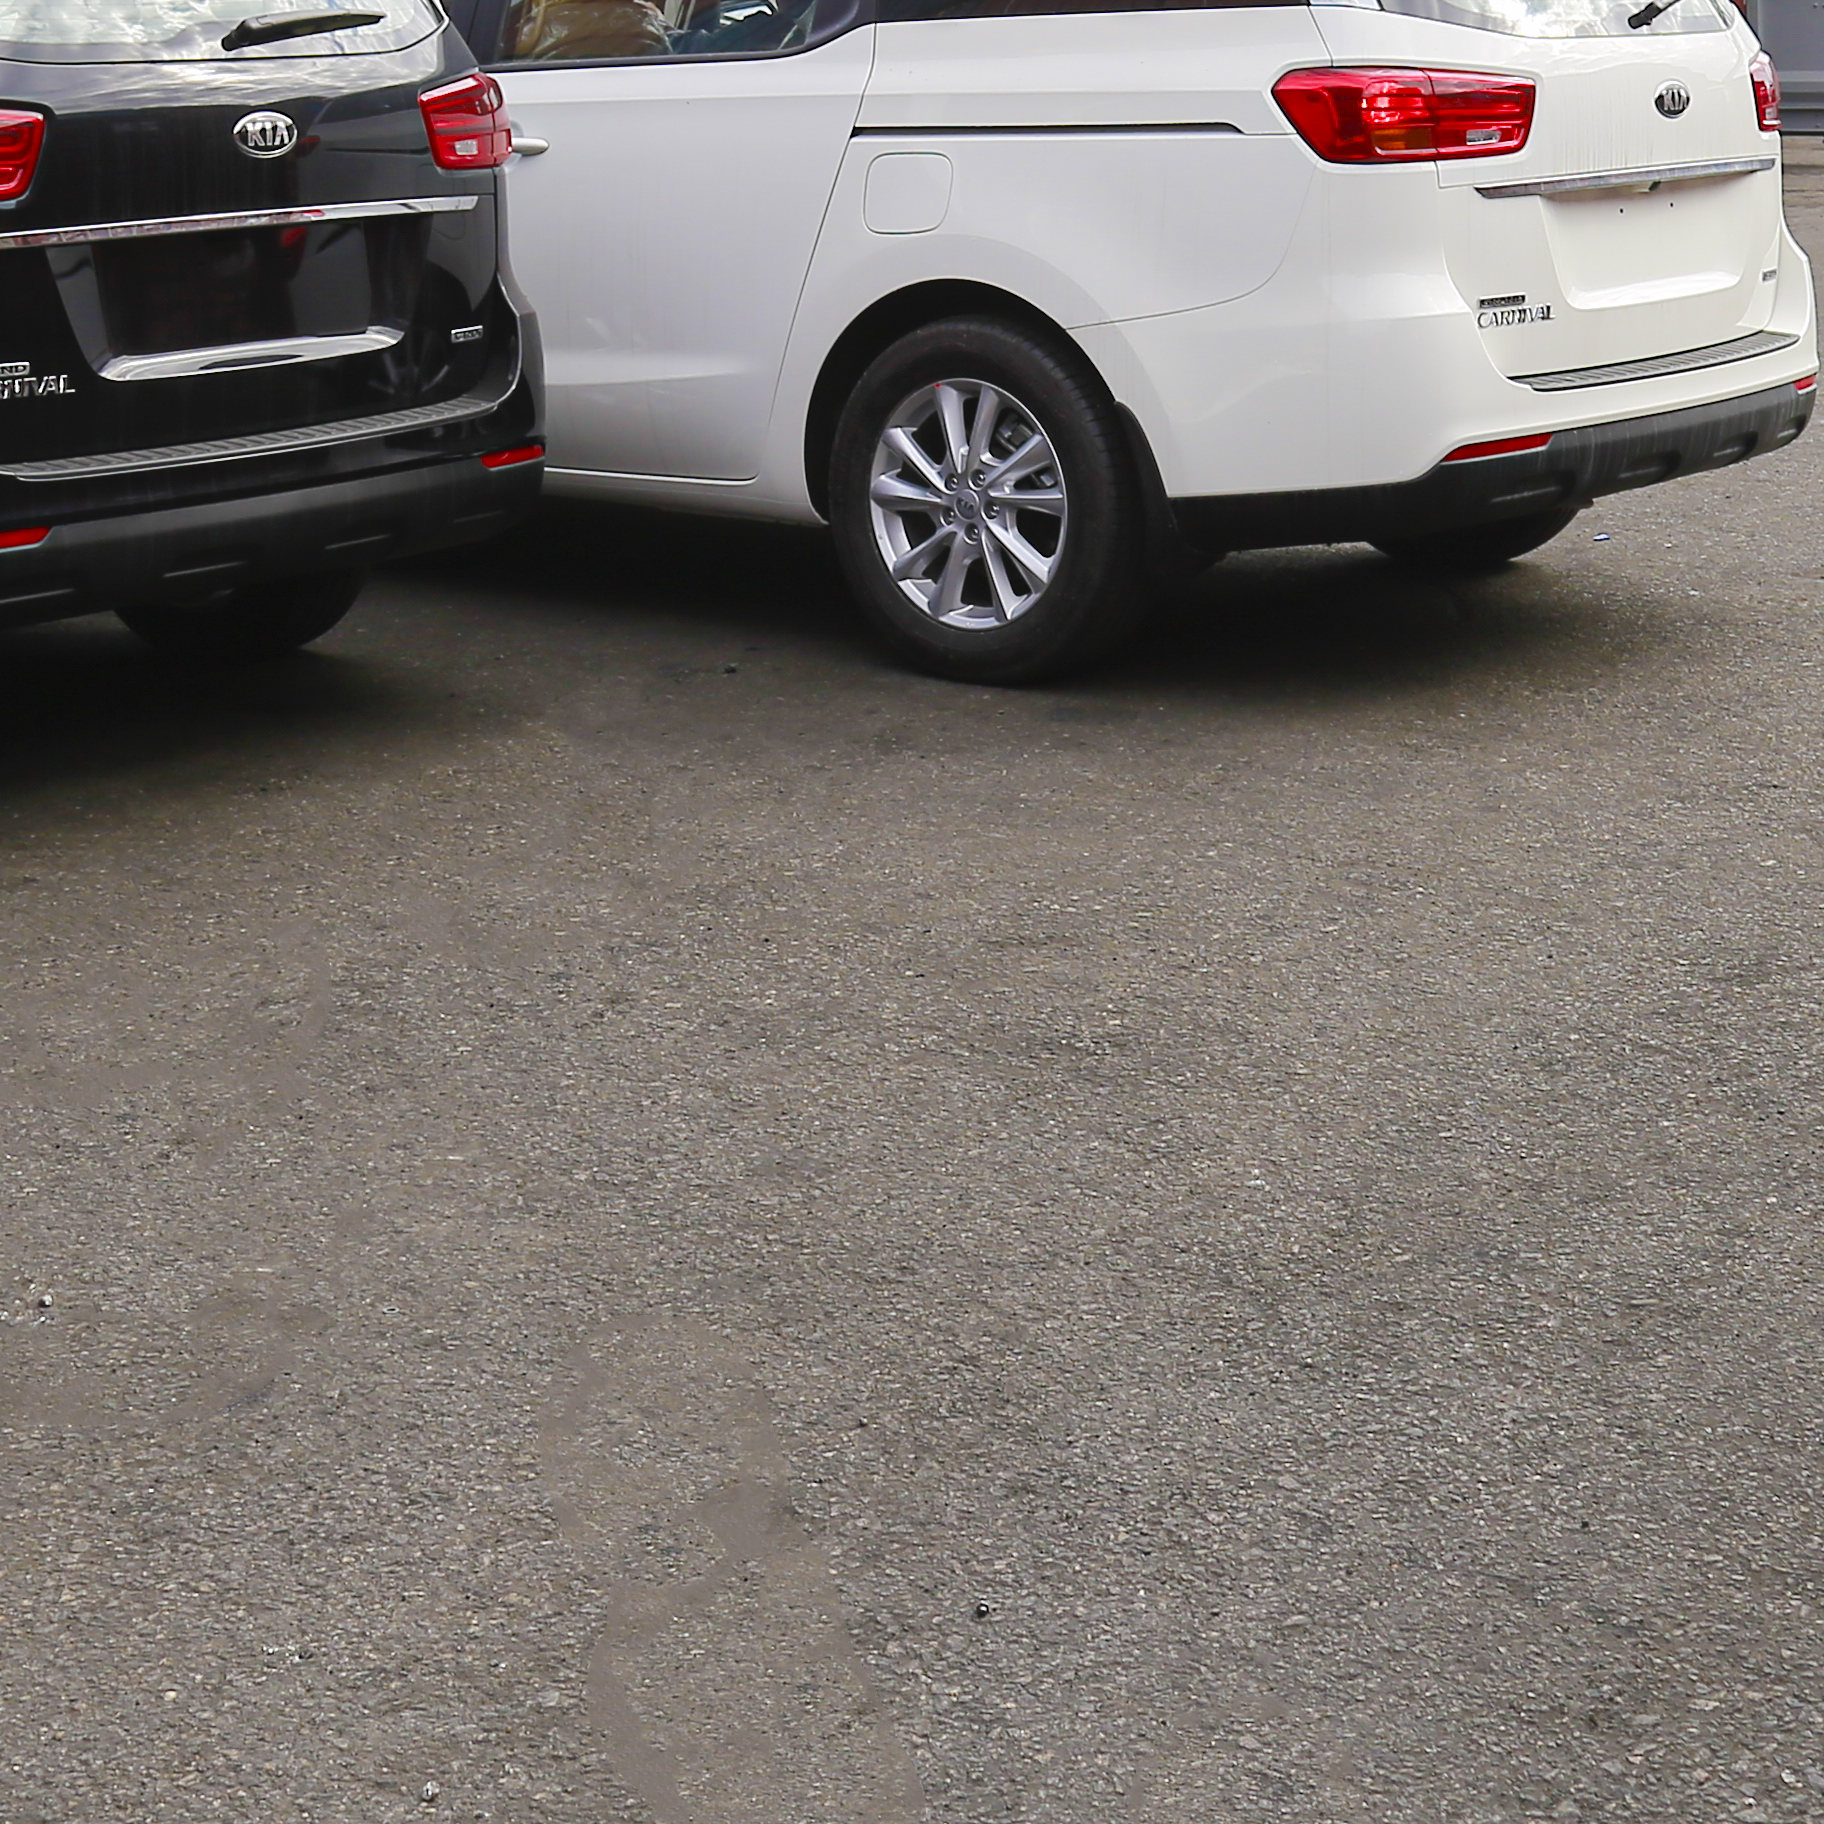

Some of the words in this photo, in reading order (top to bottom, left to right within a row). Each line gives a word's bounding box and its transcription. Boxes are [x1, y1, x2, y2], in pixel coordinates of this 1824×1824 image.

[1661, 88, 1687, 111] KIA
[245, 121, 290, 147] KIA
[1477, 303, 1556, 329] CARNIVAL
